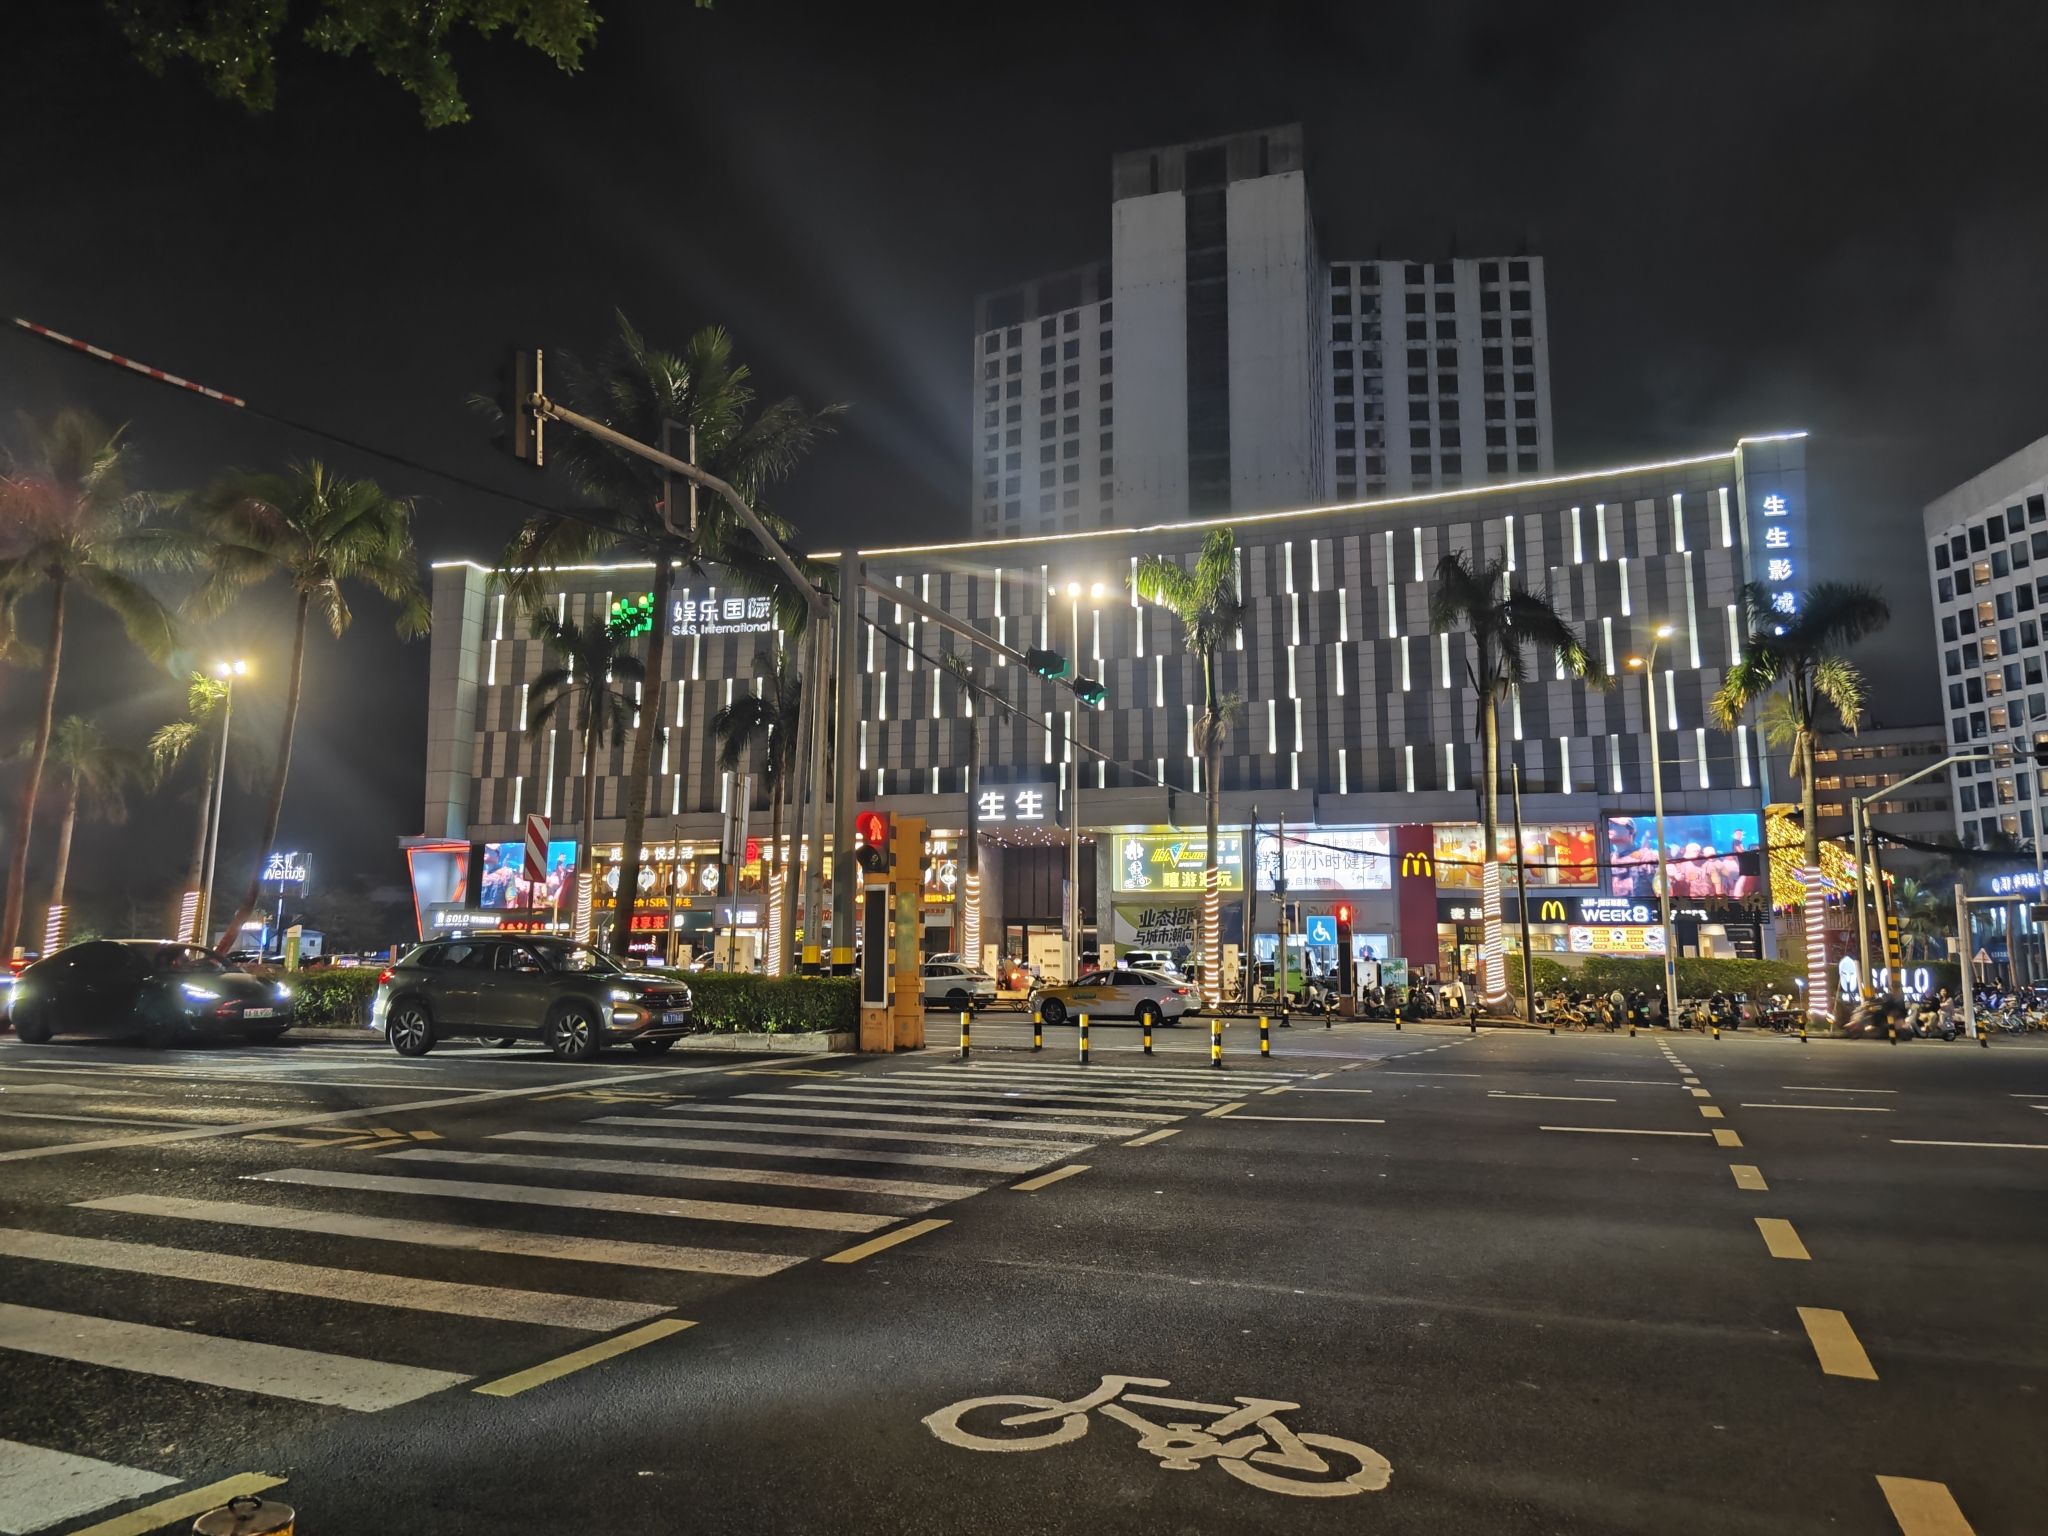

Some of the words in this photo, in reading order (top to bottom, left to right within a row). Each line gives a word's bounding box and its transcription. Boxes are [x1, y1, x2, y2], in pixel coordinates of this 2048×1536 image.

[671, 624, 696, 636] S&S
[700, 623, 770, 635] International
[978, 791, 1044, 821] 生生
[446, 914, 470, 924] SOLO
